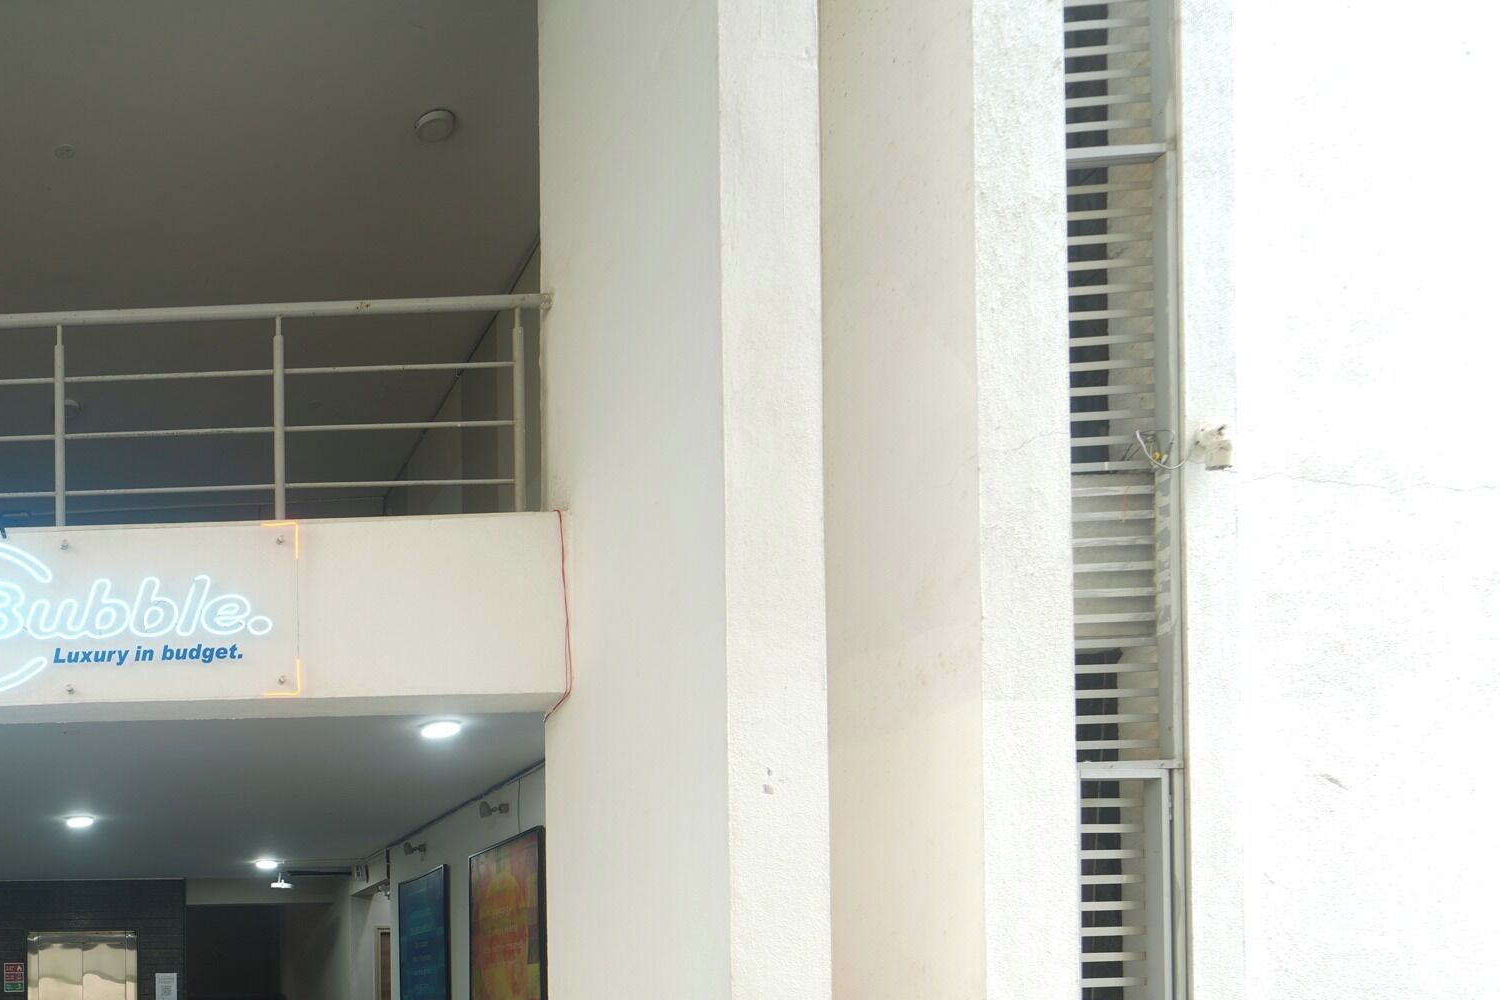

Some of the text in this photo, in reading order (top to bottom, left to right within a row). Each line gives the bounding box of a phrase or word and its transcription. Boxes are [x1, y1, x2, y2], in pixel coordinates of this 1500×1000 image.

[53, 643, 244, 666] Luxury in budget.
